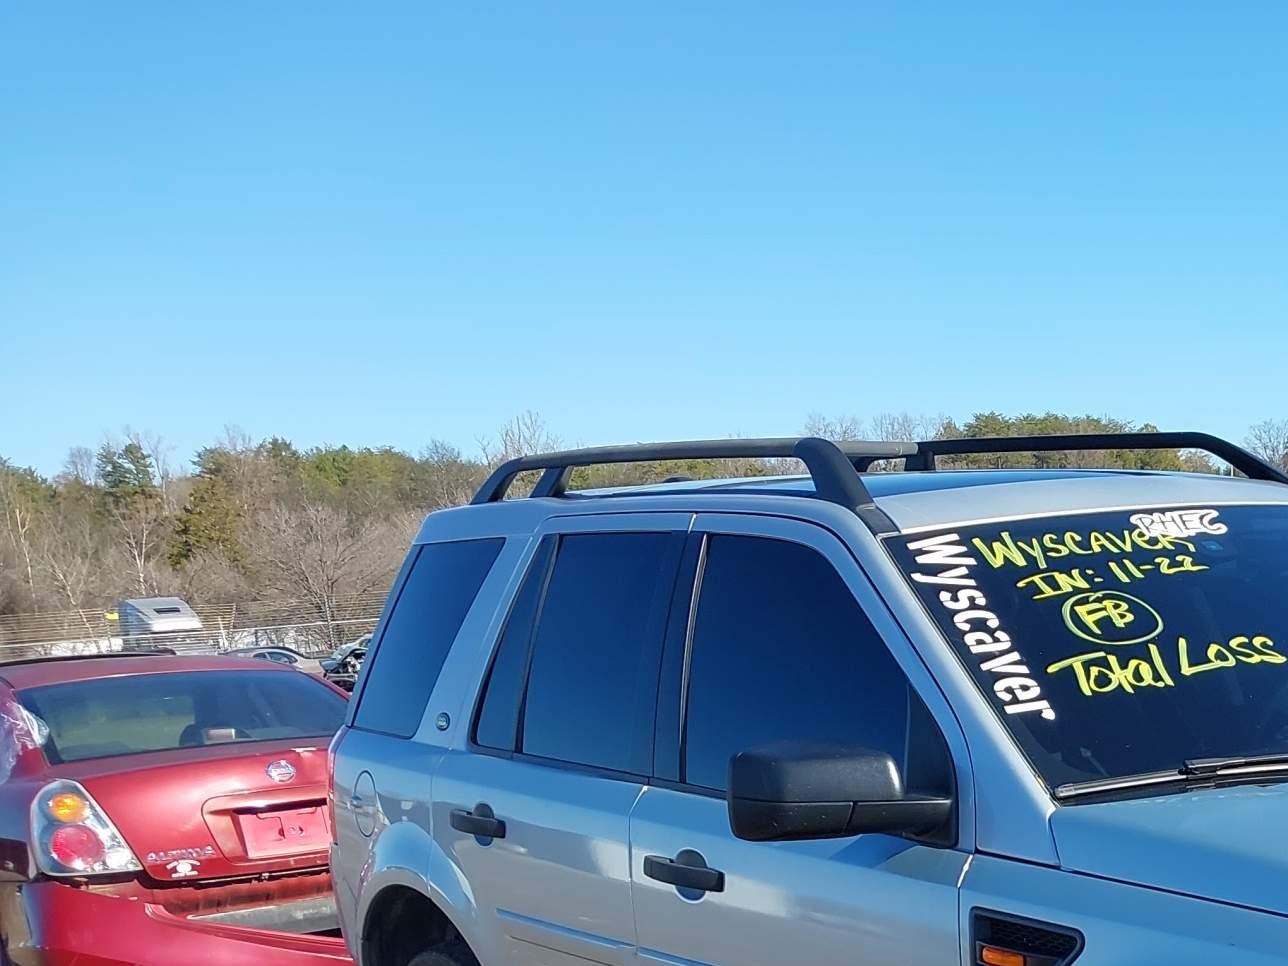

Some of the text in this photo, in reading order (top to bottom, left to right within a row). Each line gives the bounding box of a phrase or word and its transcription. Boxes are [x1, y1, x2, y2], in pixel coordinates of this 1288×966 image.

[1108, 554, 1210, 584] 11-22
[906, 533, 1056, 721] Wyscaver
[1046, 643, 1175, 696] Total
